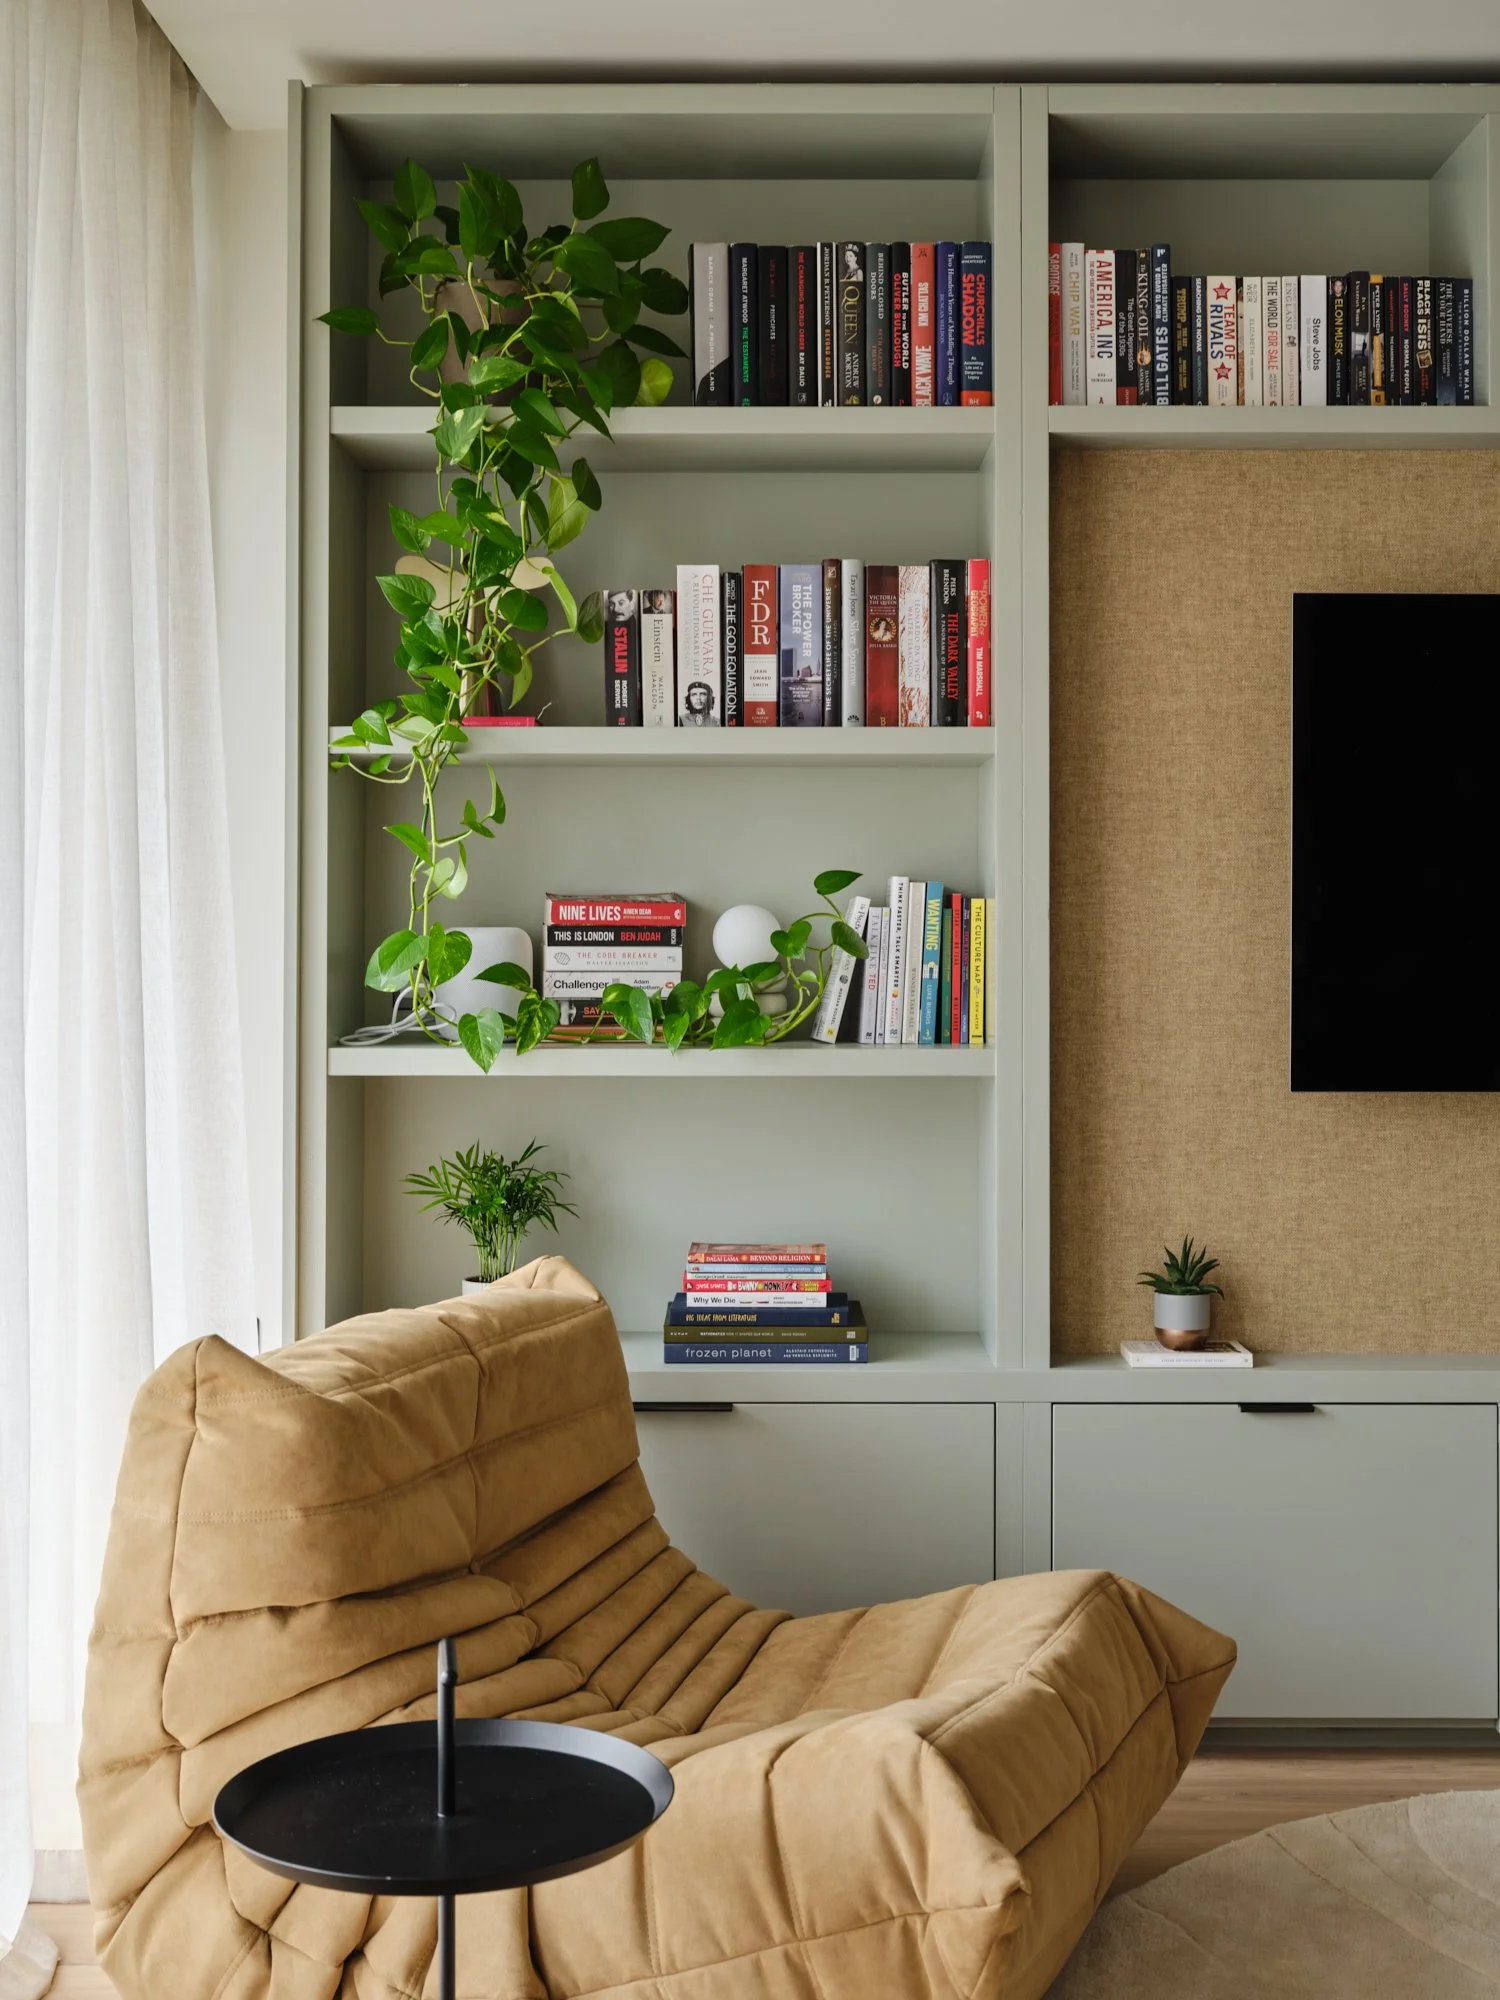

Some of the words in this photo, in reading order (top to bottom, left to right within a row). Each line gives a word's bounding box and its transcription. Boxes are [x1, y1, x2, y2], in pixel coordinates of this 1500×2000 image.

[1069, 272, 1079, 302] CHIP
[1095, 260, 1112, 331] AMERICA,
[1267, 281, 1278, 295] THE
[841, 286, 860, 344] QUEEN
[963, 273, 974, 346] SHADOW
[977, 274, 985, 345] CHURCHILL'S
[1176, 288, 1186, 322] TRUMP
[1267, 298, 1278, 327] WORLD
[1334, 299, 1343, 325] ELON
[1070, 307, 1080, 336] WAR
[1210, 304, 1223, 359] RIVALS
[1224, 304, 1235, 339] TEAM
[1418, 319, 1426, 350] ISIS
[1097, 334, 1112, 358] INC
[1156, 327, 1168, 372] GATES
[1224, 344, 1235, 360] OF
[1267, 331, 1278, 348] FOR
[1334, 327, 1343, 355] MUSK
[916, 346, 931, 375] WAVE
[1267, 350, 1278, 370] SALE
[916, 375, 931, 406] BLACK
[1156, 375, 1168, 405] BILL
[703, 575, 714, 603] CHE
[803, 584, 812, 608] THE
[727, 604, 736, 623] THE
[751, 580, 771, 645] FDR
[792, 585, 801, 634] BROKER
[948, 613, 958, 632] THE
[614, 627, 627, 672] STALIN
[653, 619, 663, 662] Einstein
[703, 609, 714, 677] GUEVARA
[727, 626, 736, 654] GOD
[803, 613, 812, 657] POWER
[826, 640, 831, 650] OF
[948, 636, 958, 662] DARK
[914, 645, 920, 655] DA
[727, 656, 736, 714] EQUATION
[948, 666, 958, 700] VALLEY
[560, 906, 586, 921] NINE
[589, 905, 621, 921] LIVES
[926, 899, 940, 952] WANTING
[554, 932, 571, 941] THIS
[574, 932, 582, 941] IS
[584, 932, 614, 941] LONDON
[621, 932, 636, 941] BEN
[638, 932, 660, 941] JUDAH
[554, 980, 609, 990] Challenger
[584, 1007, 600, 1015] SAY
[729, 1314, 757, 1322] LITERATURE
[685, 1348, 726, 1358] frozen
[732, 1348, 772, 1358] planet
